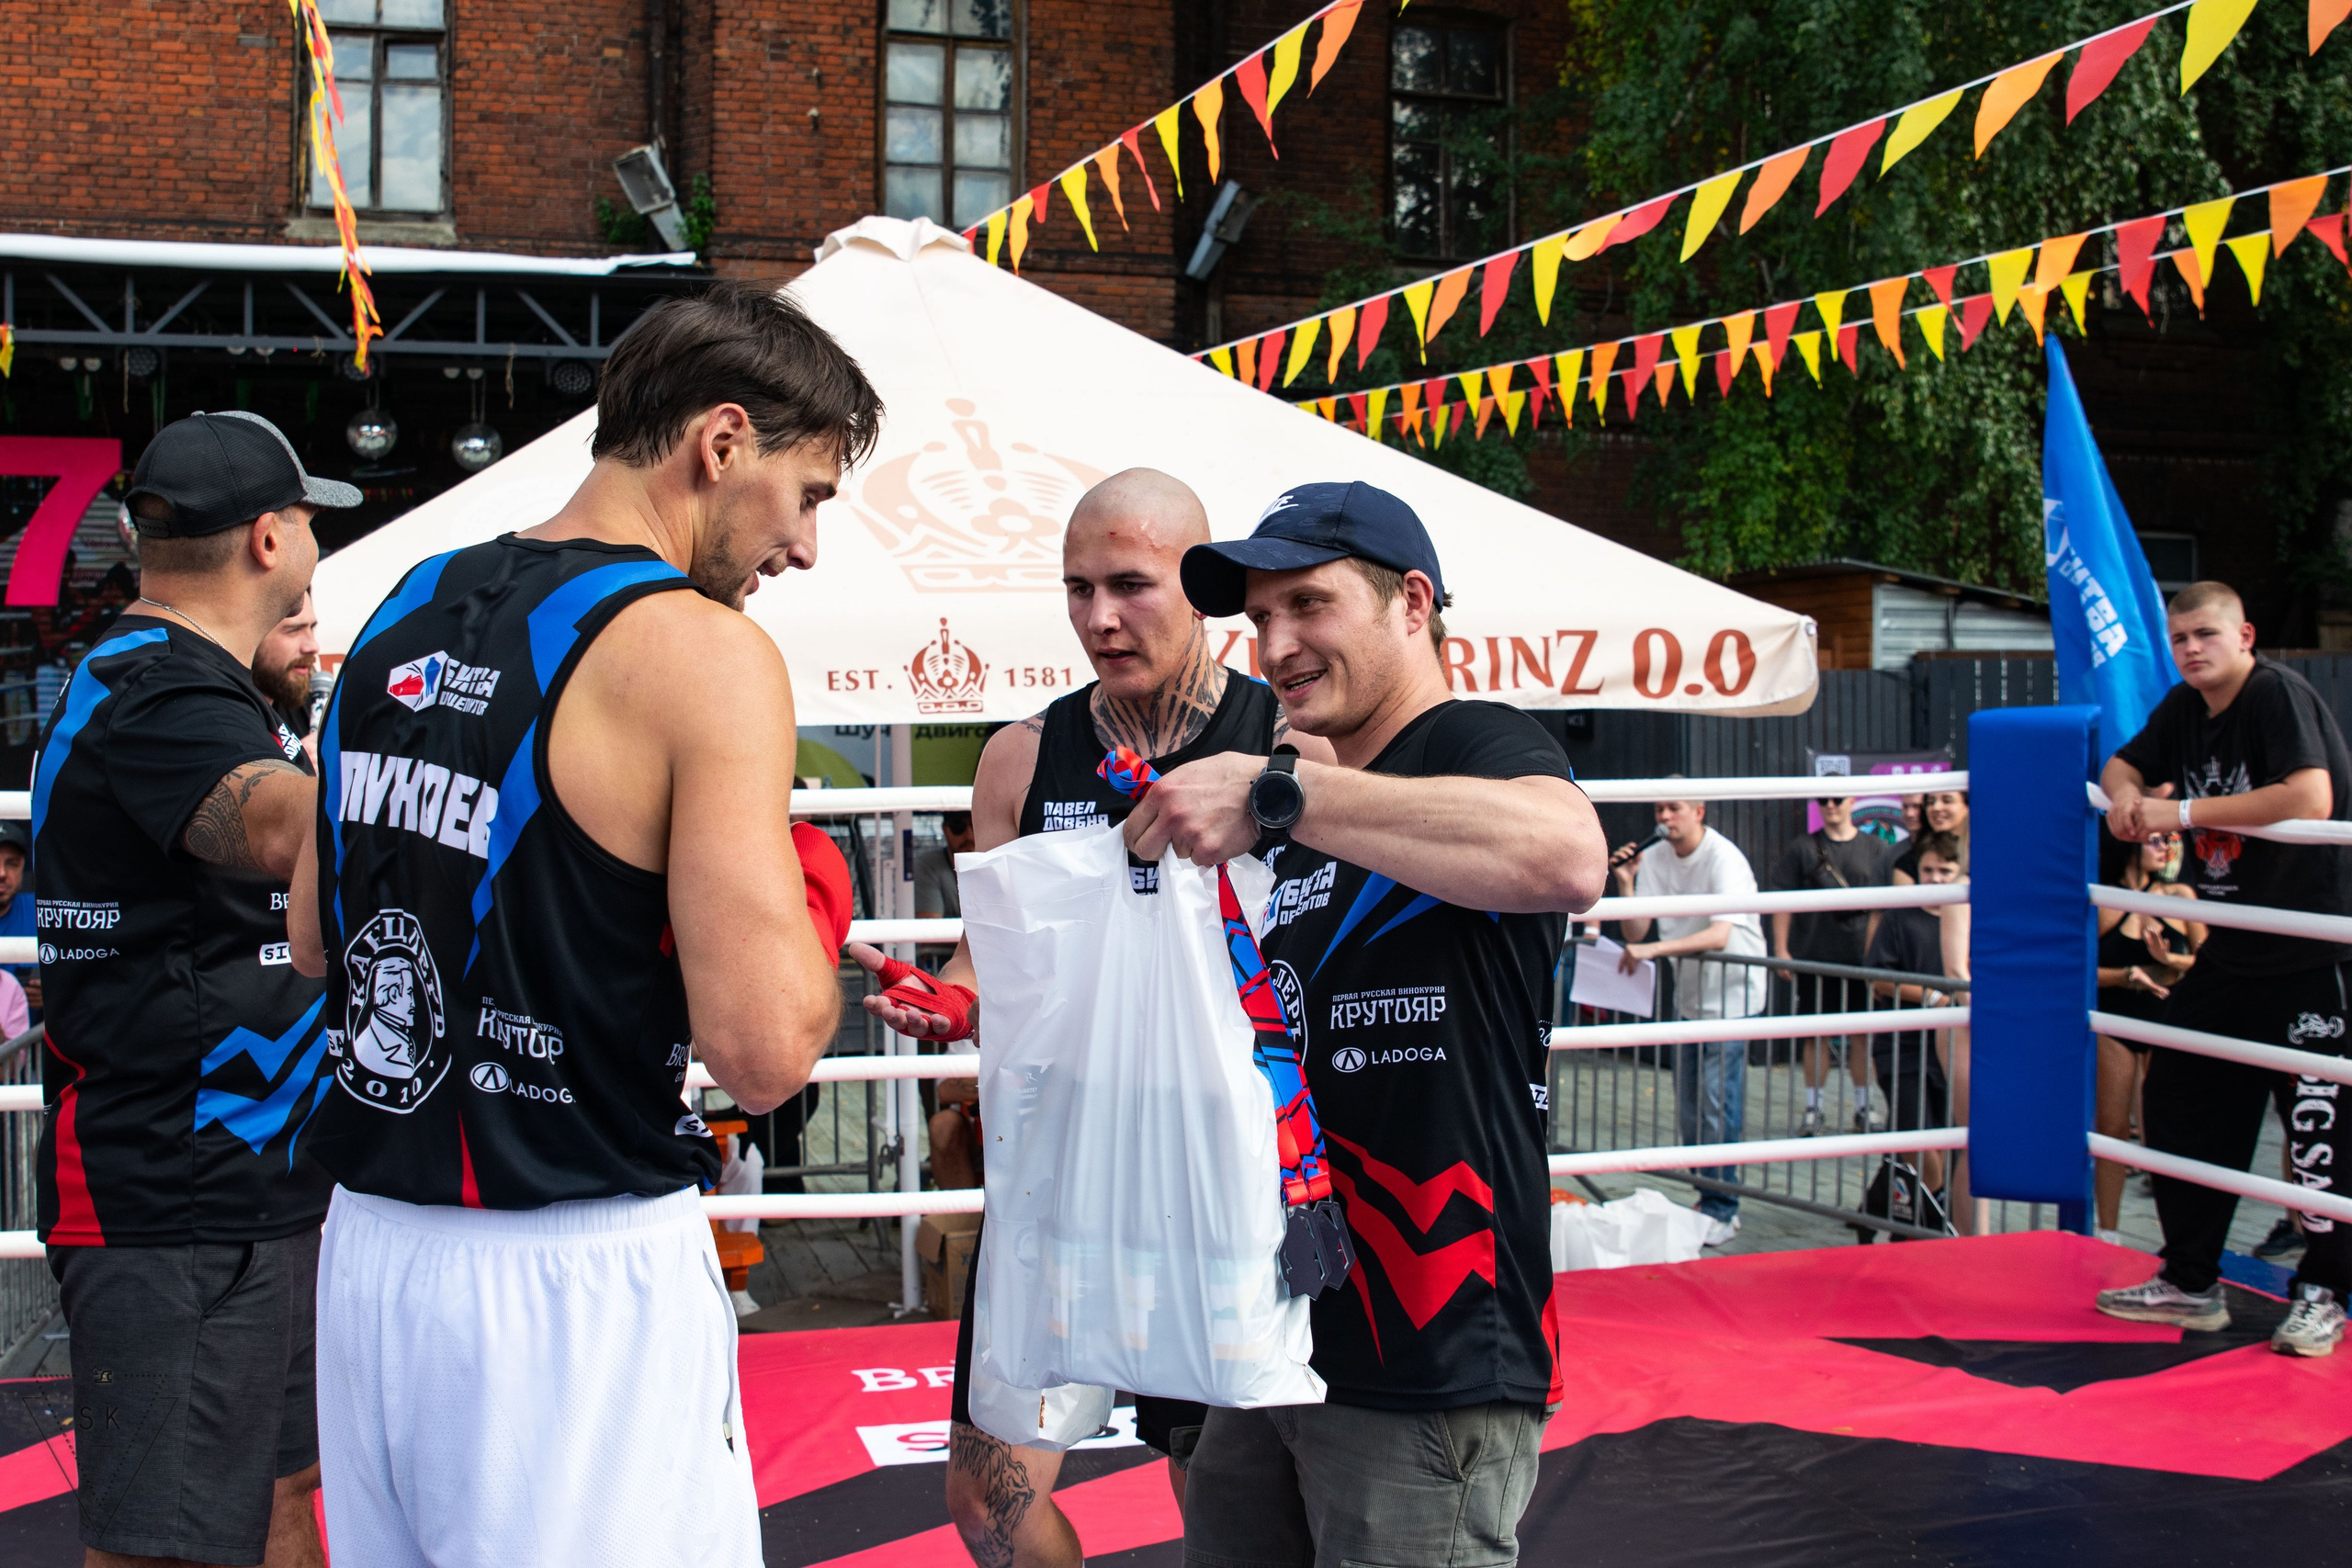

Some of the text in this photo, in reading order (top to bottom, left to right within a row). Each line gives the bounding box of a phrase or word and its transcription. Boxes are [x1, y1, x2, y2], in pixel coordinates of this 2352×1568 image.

[1632, 628, 1757, 699] 0.0
[827, 669, 893, 692] EST.
[1004, 666, 1073, 689] 1581
[1043, 801, 1097, 817] ПАВЕЛ
[37, 907, 121, 930] КРУТОЯР
[60, 947, 120, 961] LADOGA
[1332, 986, 1445, 1002] ПЕРВАЯ РУССКАЯ ВИНОКУРНЯ
[1329, 996, 1447, 1030] КРУТОЯР
[1371, 1047, 1447, 1065] LADOGA
